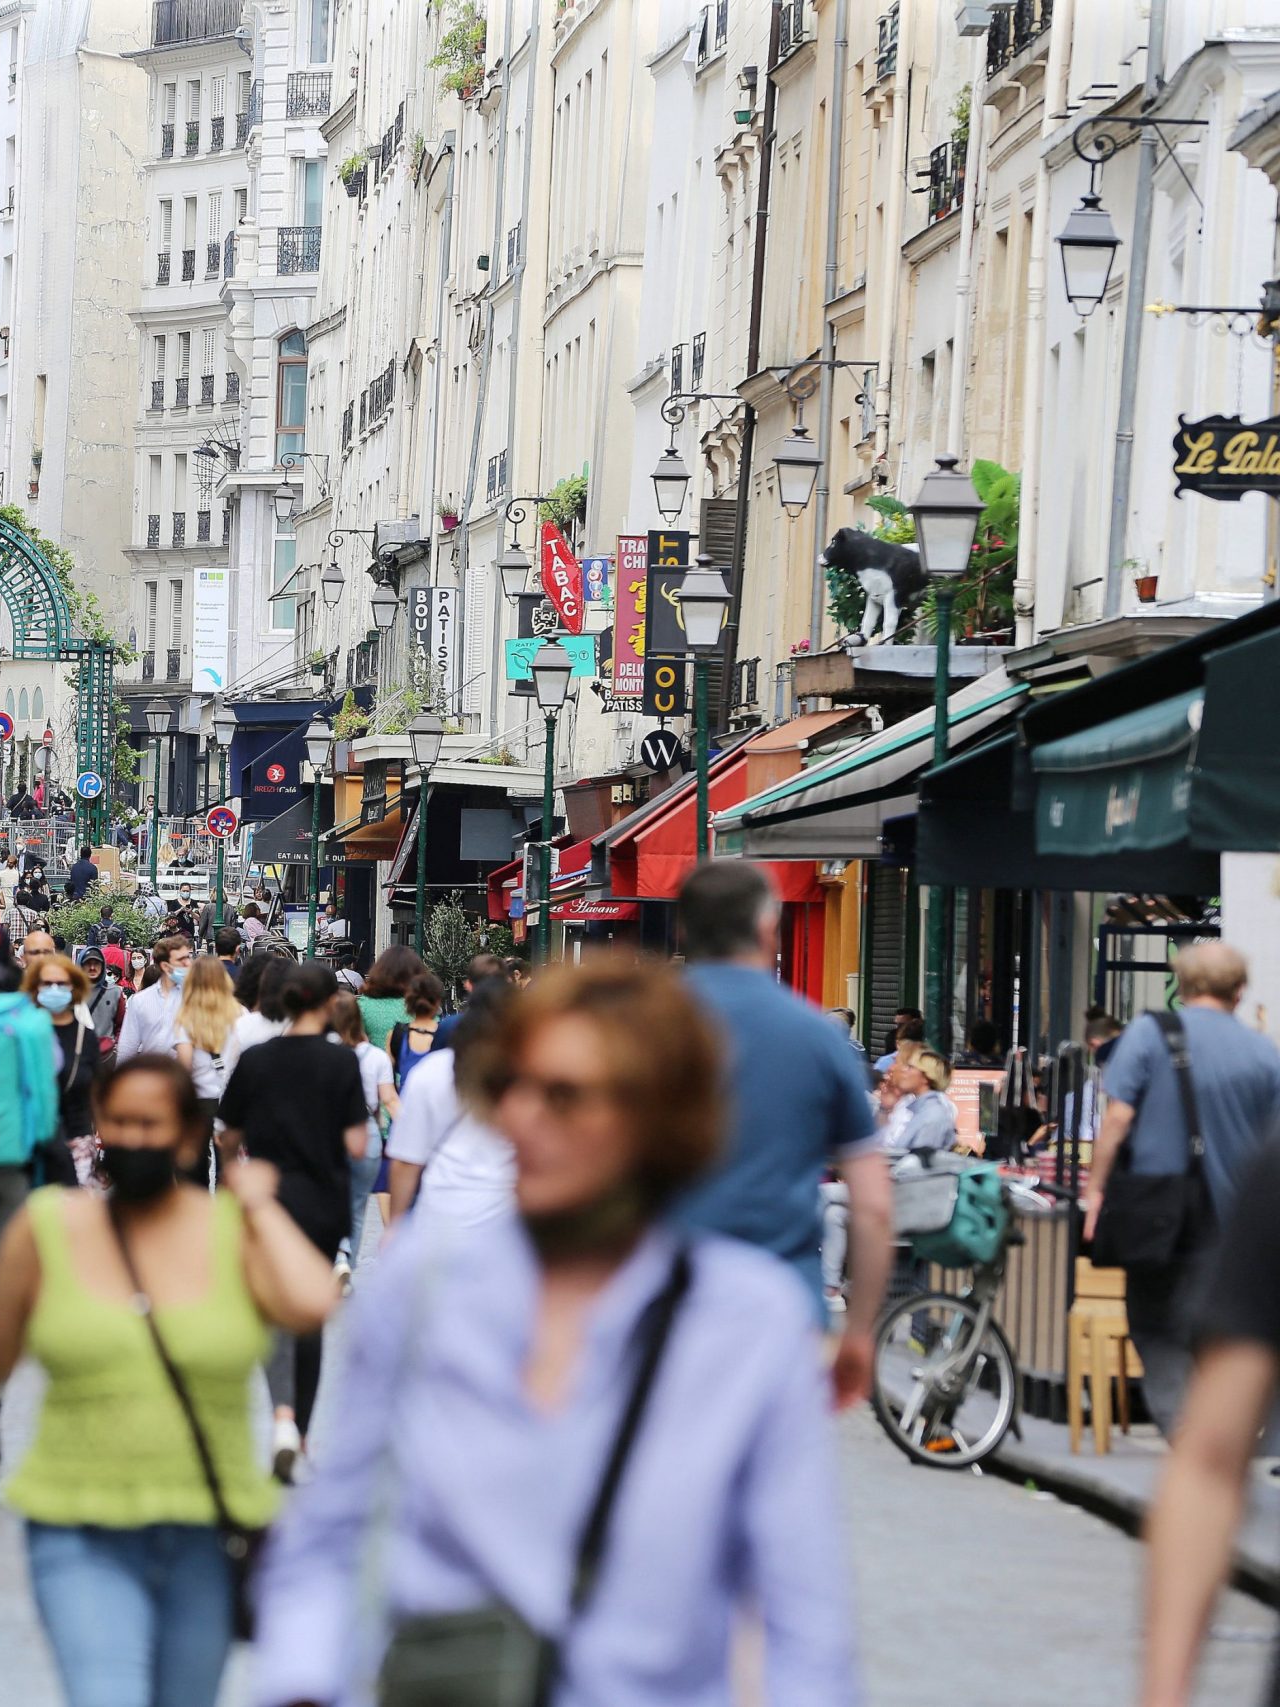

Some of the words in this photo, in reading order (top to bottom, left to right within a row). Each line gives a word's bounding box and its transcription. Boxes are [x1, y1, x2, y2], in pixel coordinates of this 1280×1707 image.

[1175, 431, 1217, 474] Le
[546, 539, 578, 617] TABAC
[643, 739, 678, 766] W
